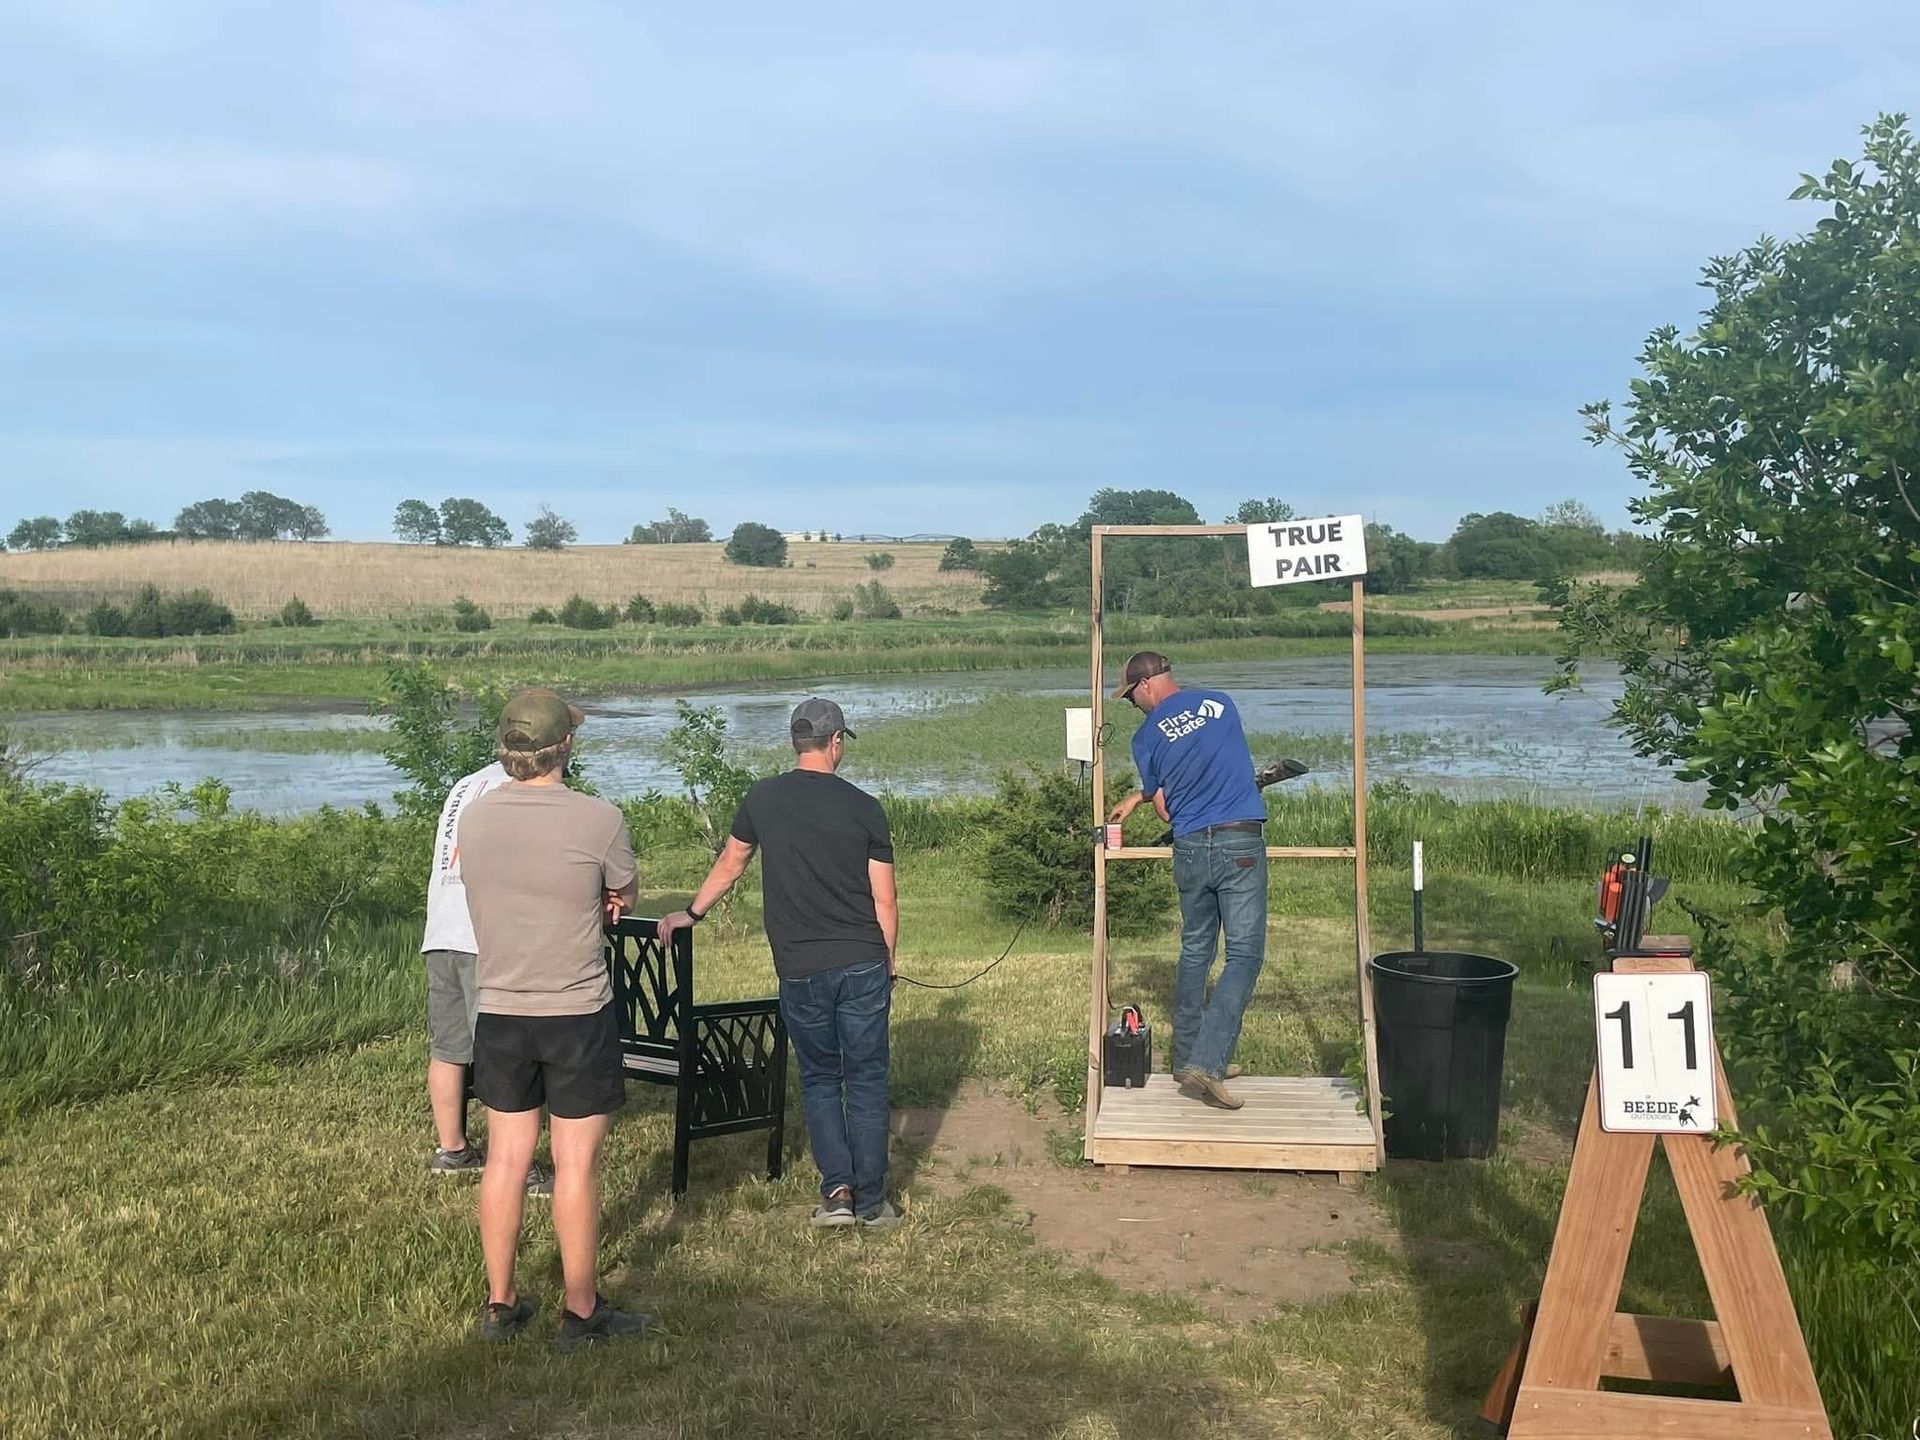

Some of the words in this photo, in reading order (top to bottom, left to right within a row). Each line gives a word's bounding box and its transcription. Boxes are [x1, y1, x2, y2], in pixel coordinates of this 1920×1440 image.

[1268, 520, 1343, 548] TRUE
[1276, 553, 1343, 579] PAIR
[1157, 709, 1195, 733] First
[1165, 716, 1207, 742] State
[1623, 1101, 1679, 1114] BEEDE
[1631, 1113, 1672, 1121] OUTDOORS
